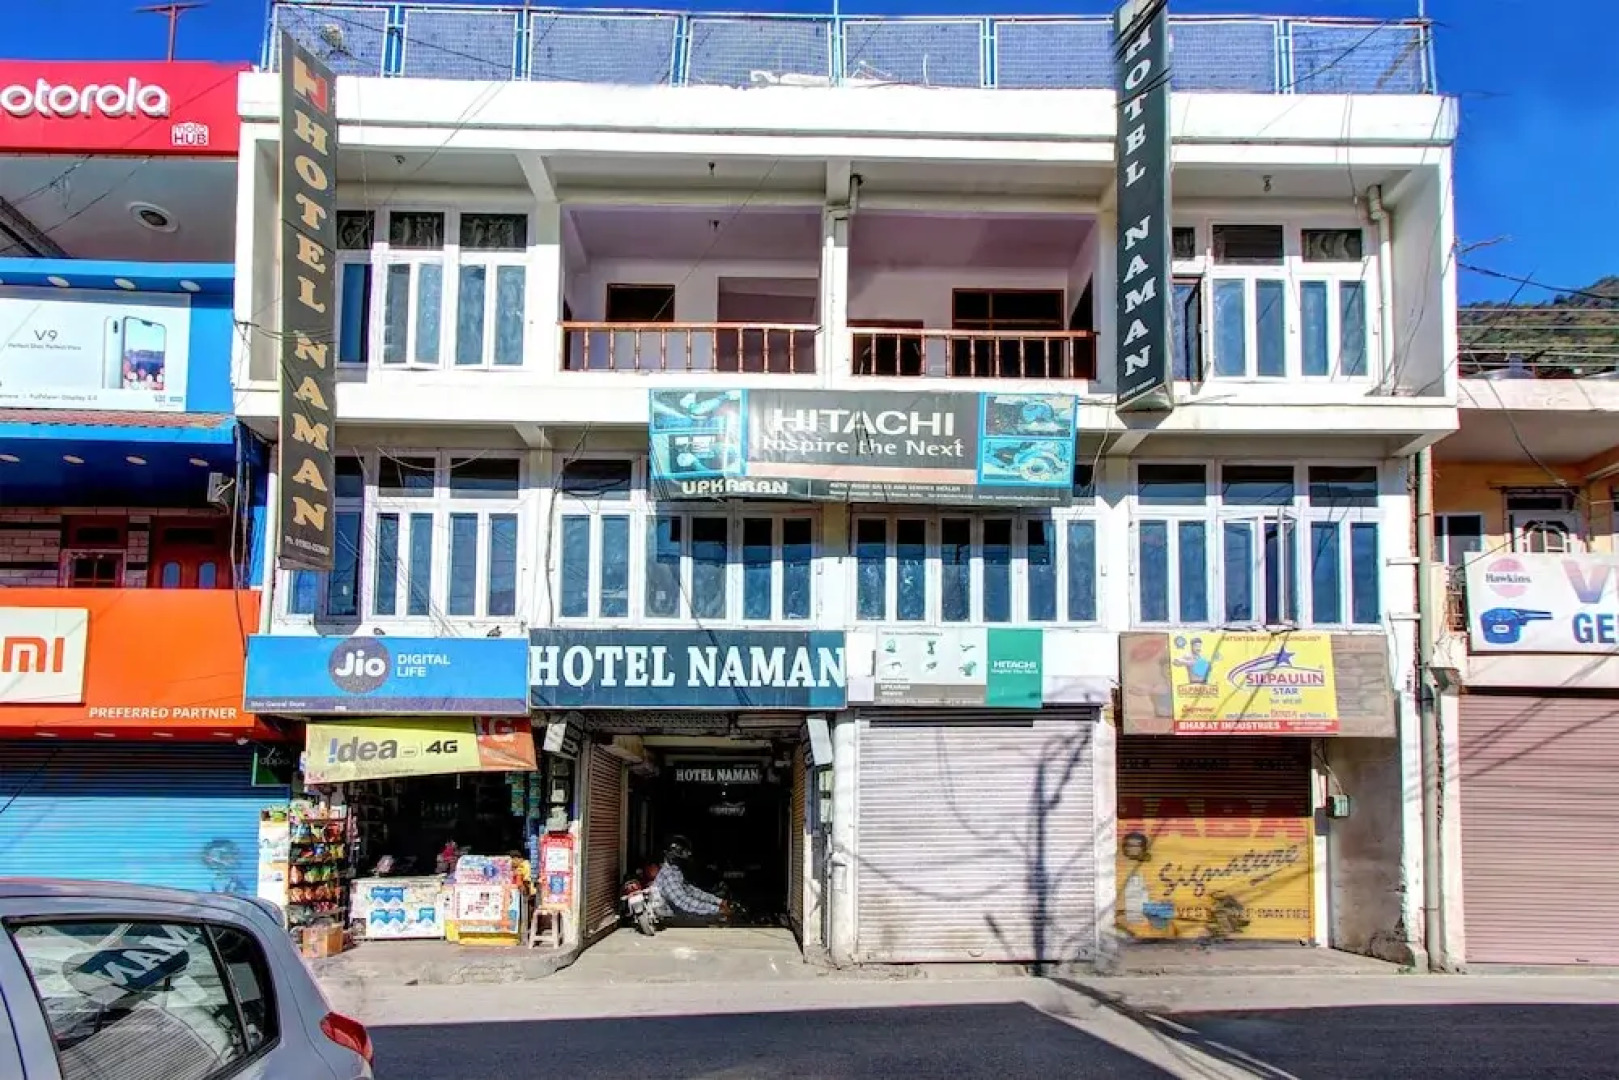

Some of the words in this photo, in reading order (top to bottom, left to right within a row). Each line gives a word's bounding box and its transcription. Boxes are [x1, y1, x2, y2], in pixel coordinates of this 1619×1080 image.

[0, 77, 169, 118] otorola
[1124, 23, 1152, 187] HOTEL
[174, 133, 206, 145] HUB
[294, 109, 328, 311] HOTEL
[1123, 214, 1157, 377] NAMAN
[33, 329, 58, 341] V9
[292, 330, 328, 531] NAMAN
[773, 408, 955, 437] HITACHI
[763, 433, 850, 456] Inspire
[859, 437, 898, 456] the
[905, 438, 965, 458] Next
[682, 478, 788, 496] UPKARAN
[1561, 559, 1619, 605] V
[1572, 612, 1619, 644] GE
[334, 650, 386, 678] Jio
[396, 666, 427, 678] LIFE
[397, 653, 450, 666] DIGITAL
[530, 645, 676, 688] HOTEL
[687, 646, 846, 688] NAMAN
[1272, 687, 1299, 695] STAR
[88, 706, 169, 719] PREFERRED
[172, 707, 237, 719] PARTNER
[1179, 720, 1219, 730] BHARAT
[425, 739, 458, 755] 4G
[676, 768, 715, 782] HOTEL
[716, 768, 760, 782] NAMAN
